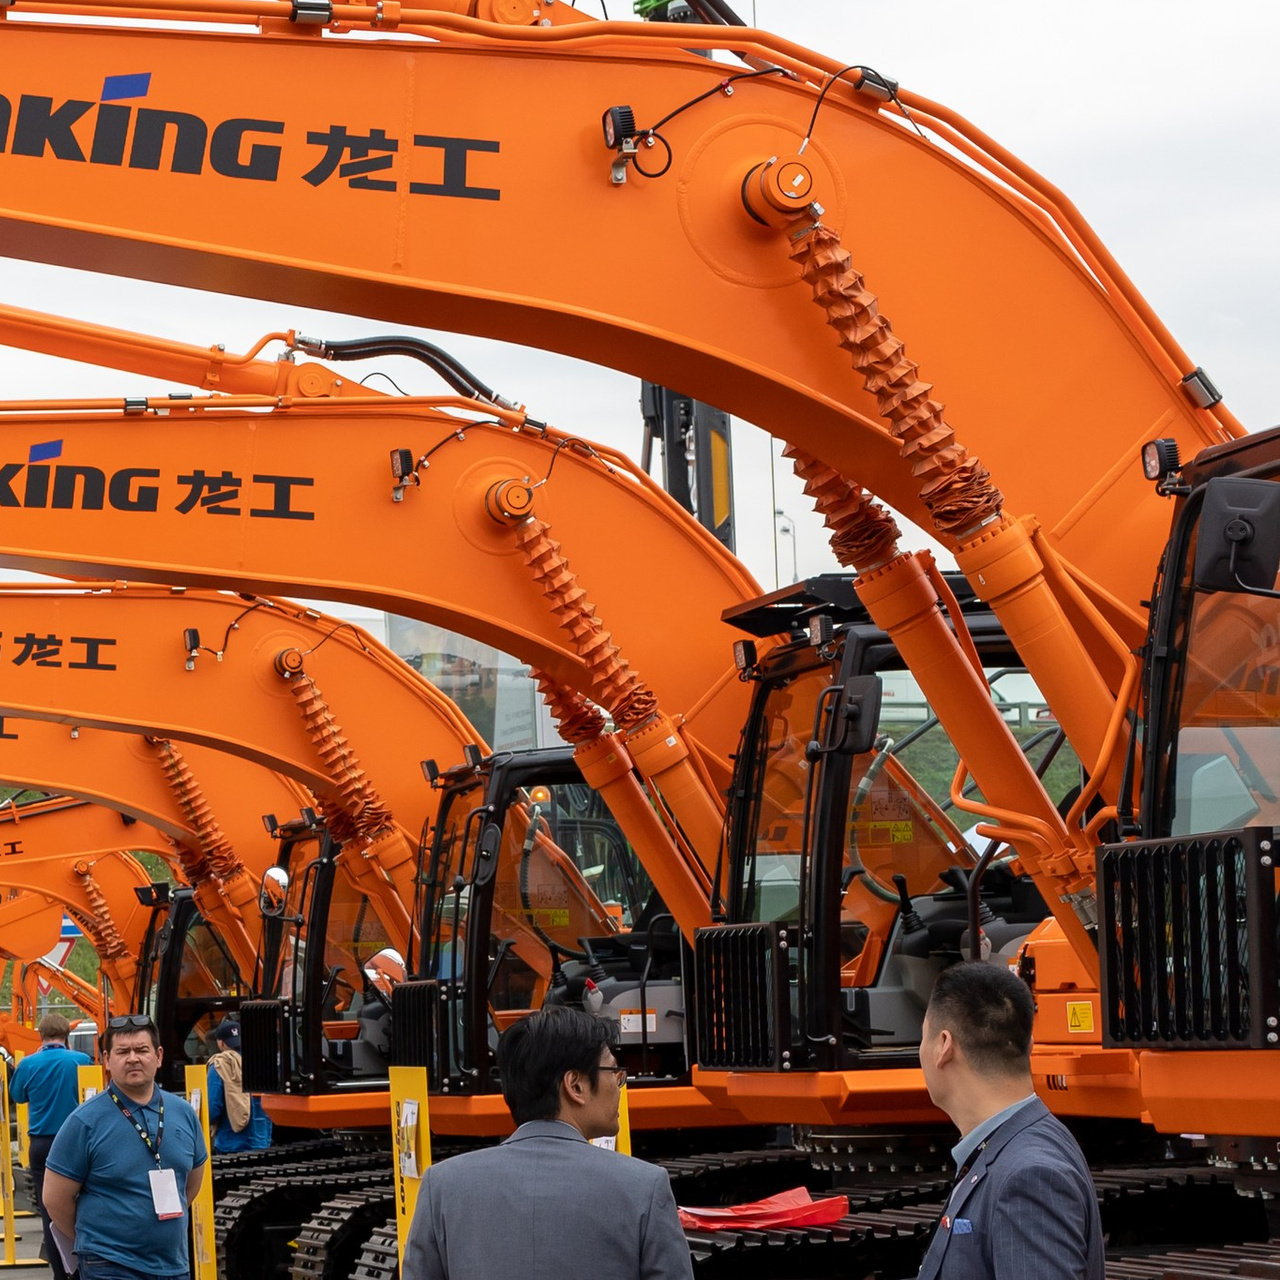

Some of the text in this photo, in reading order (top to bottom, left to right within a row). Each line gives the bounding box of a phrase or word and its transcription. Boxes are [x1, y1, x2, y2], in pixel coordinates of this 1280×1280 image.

[303, 125, 500, 201] 龙工
[176, 470, 315, 521] 龙工
[12, 632, 117, 671] 龙工
